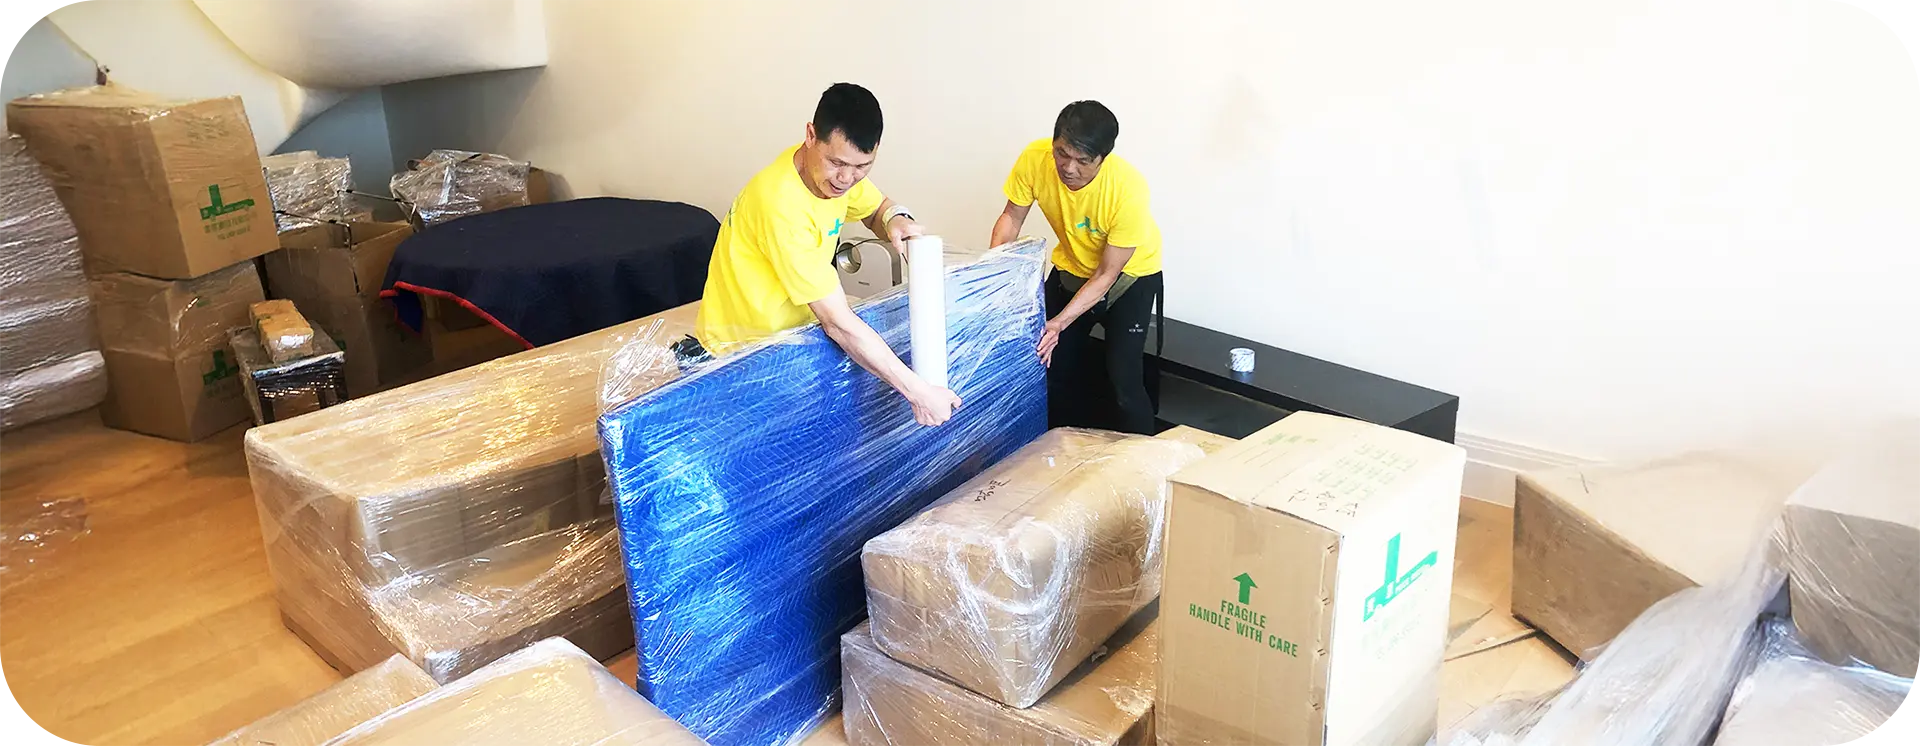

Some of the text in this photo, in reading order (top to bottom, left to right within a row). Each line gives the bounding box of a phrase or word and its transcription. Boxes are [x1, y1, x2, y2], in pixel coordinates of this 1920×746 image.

[1189, 603, 1298, 657] HANDLE WITH CARE
[1221, 600, 1266, 629] FRAGILE
